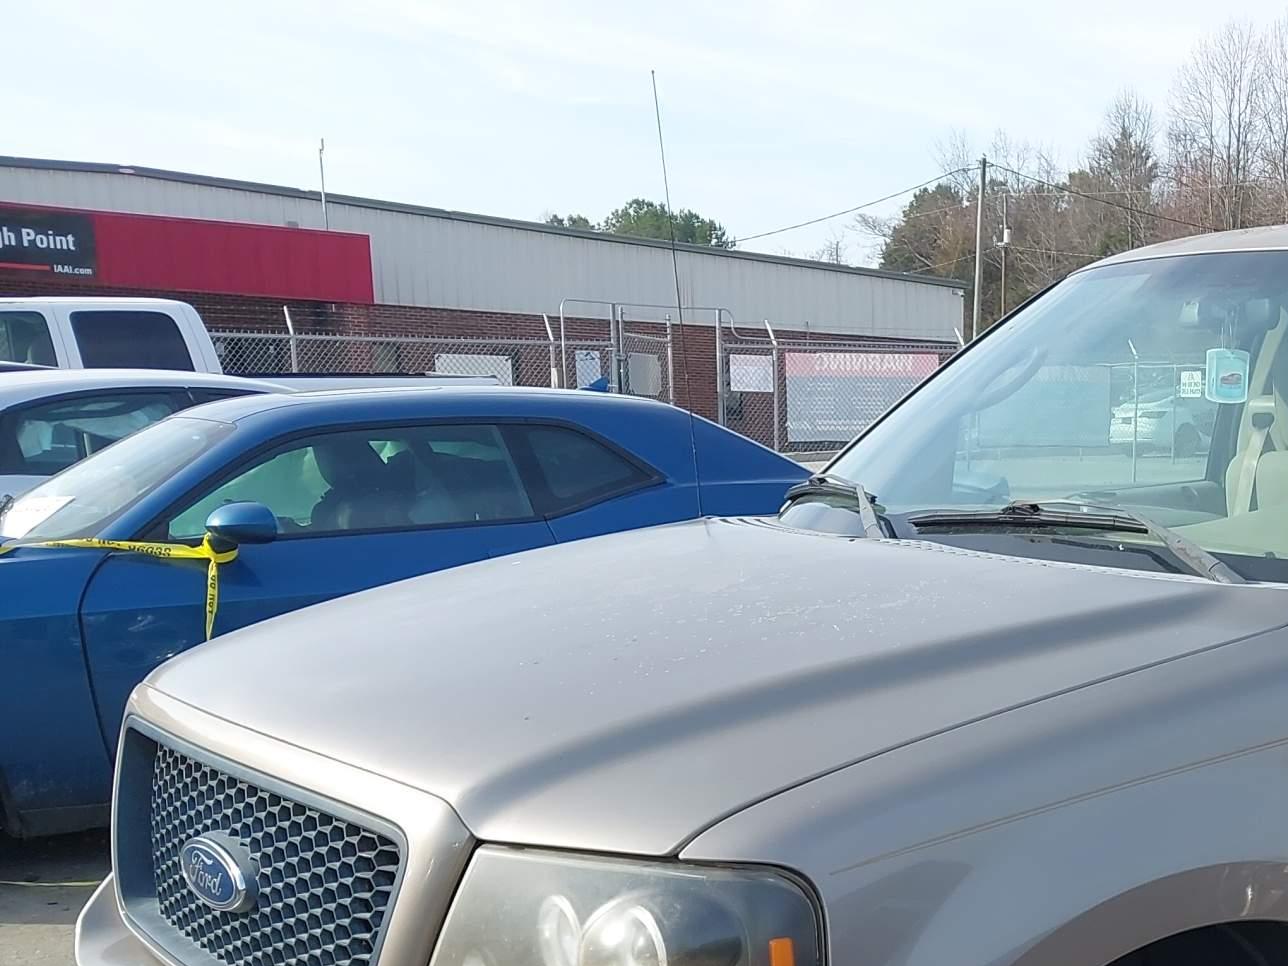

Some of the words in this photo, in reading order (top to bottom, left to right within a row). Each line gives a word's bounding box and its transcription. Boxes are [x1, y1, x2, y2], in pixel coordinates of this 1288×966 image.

[21, 228, 76, 250] Point
[53, 264, 93, 275] IAAI.com
[189, 850, 223, 896] Ford
